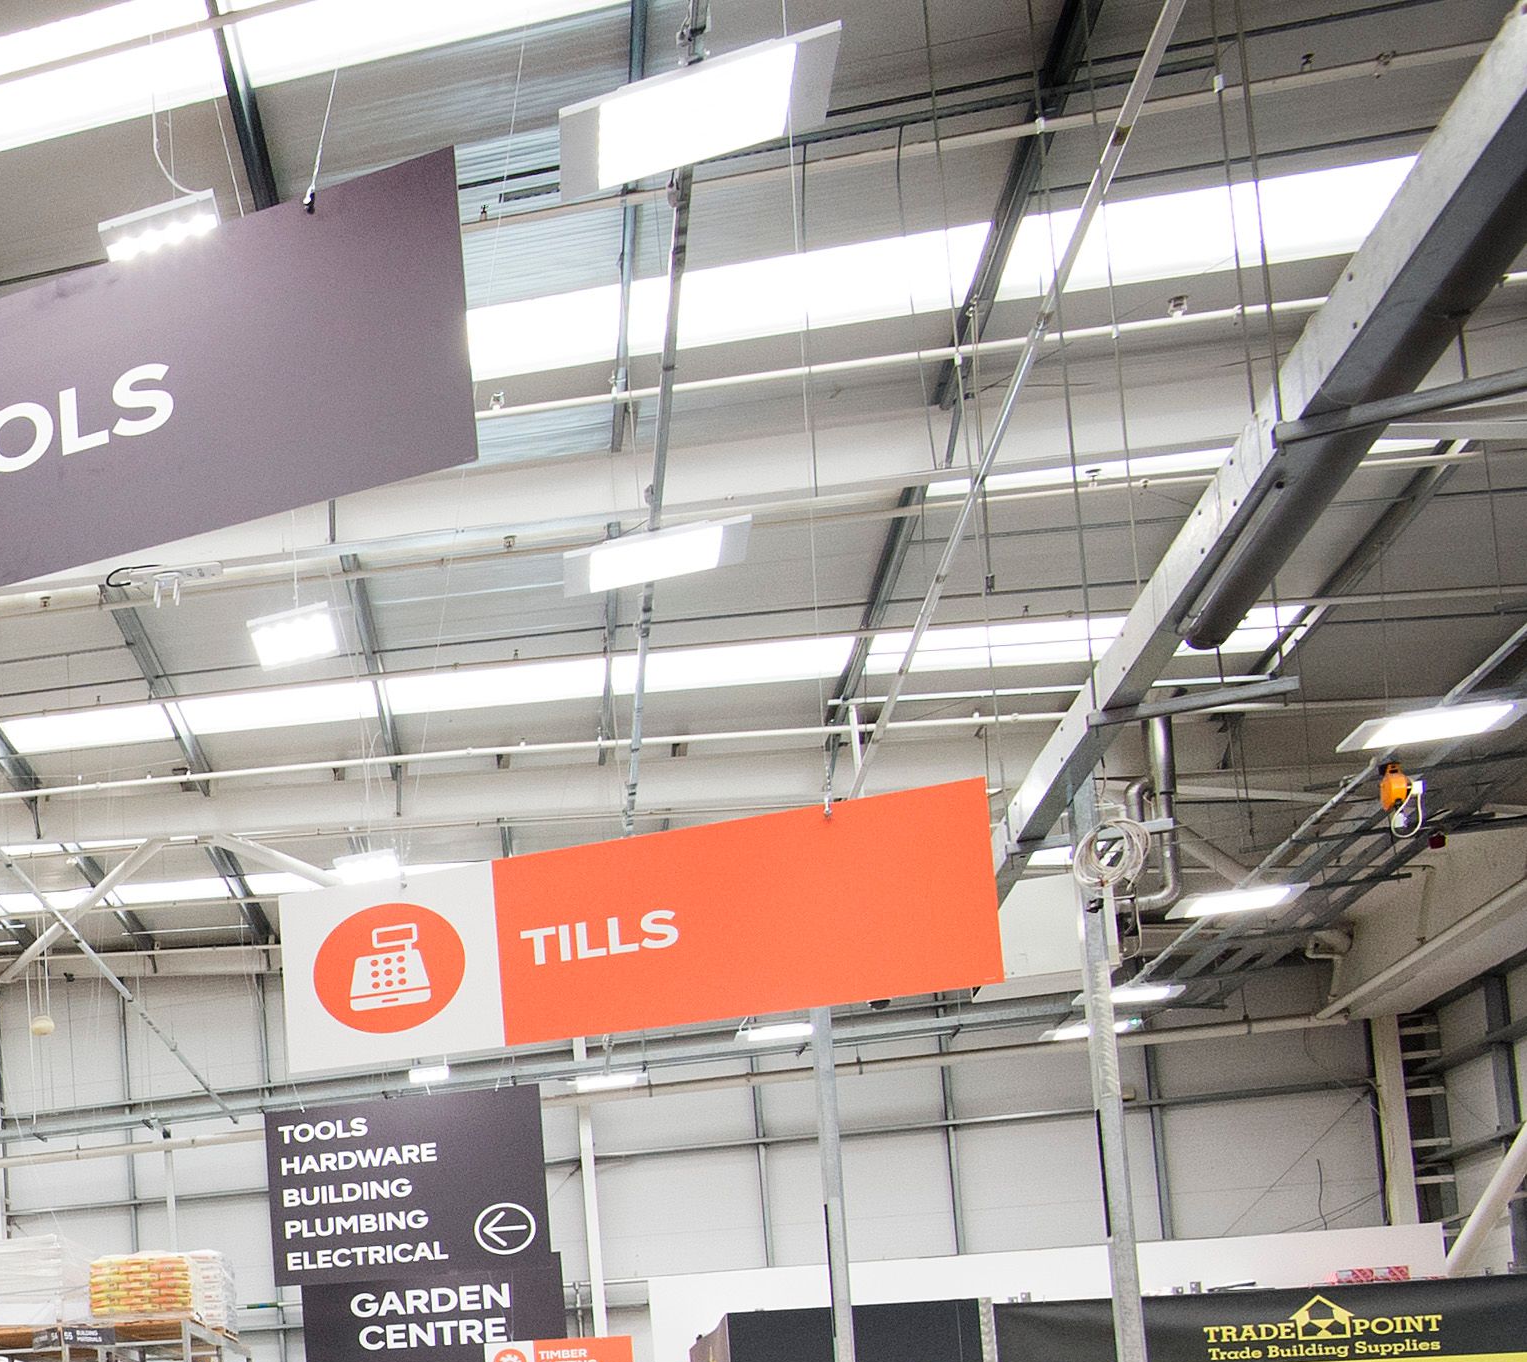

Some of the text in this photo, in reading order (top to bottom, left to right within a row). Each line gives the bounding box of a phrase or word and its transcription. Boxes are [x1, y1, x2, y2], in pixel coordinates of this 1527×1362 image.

[520, 909, 679, 966] TILLS
[278, 1118, 368, 1144] TOOLS
[281, 1143, 437, 1176] HARDWARE
[283, 1178, 412, 1207] BUILDING
[285, 1209, 429, 1239] PLUMBING
[287, 1241, 448, 1271] ELECTRICAL
[350, 1283, 511, 1318] GARDEN
[359, 1318, 508, 1350] CENTRE
[1204, 1314, 1442, 1343] TRADE POINT
[539, 1348, 588, 1359] TIMBER
[1208, 1339, 1441, 1361] Trade Building Supplies
